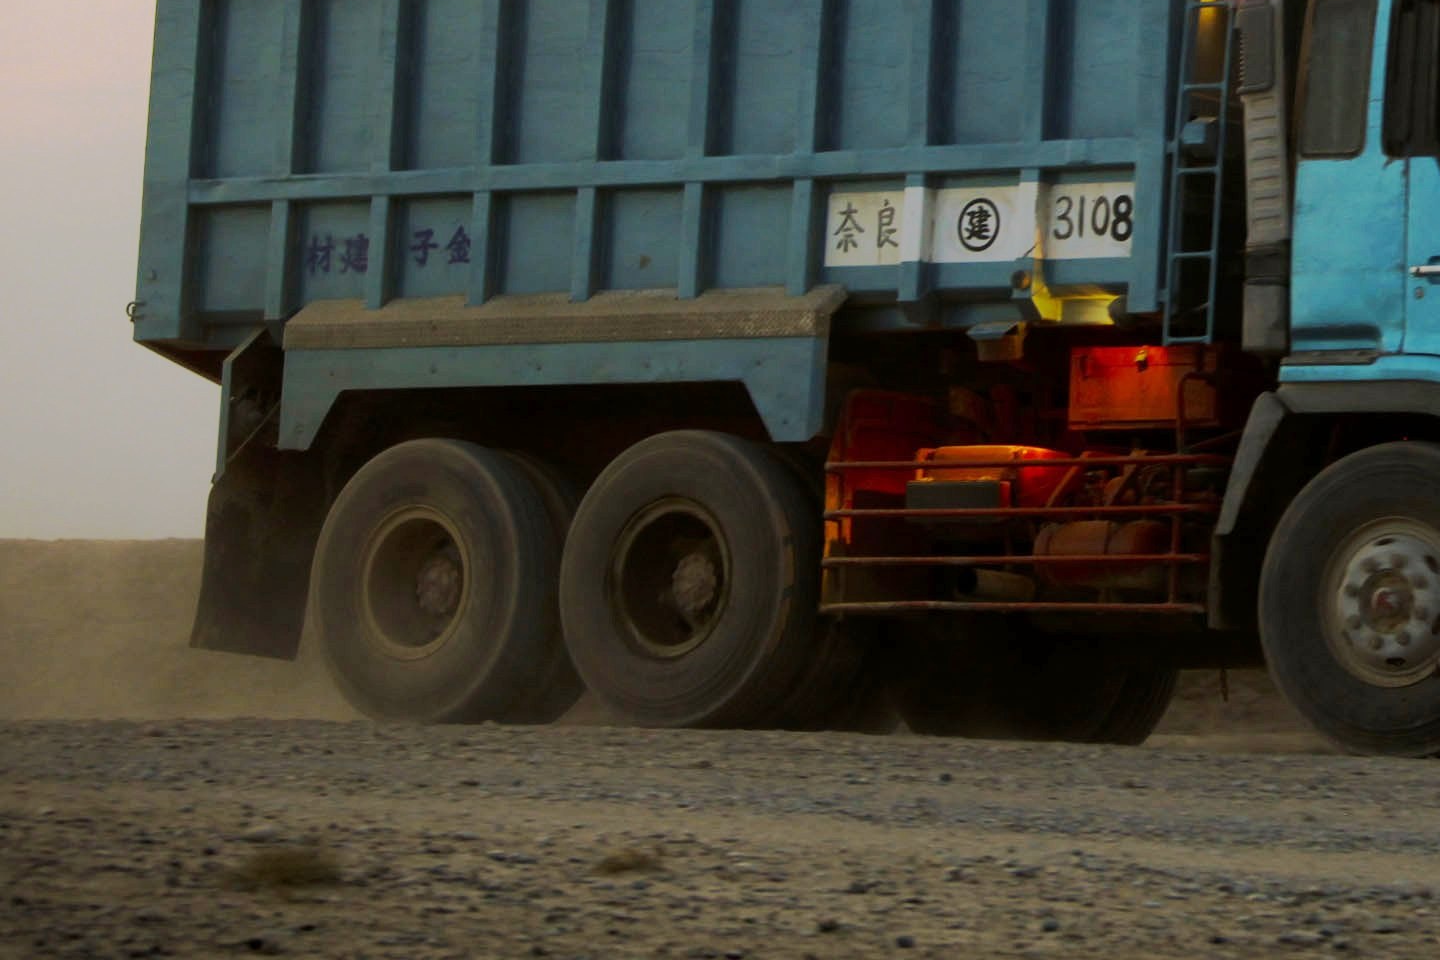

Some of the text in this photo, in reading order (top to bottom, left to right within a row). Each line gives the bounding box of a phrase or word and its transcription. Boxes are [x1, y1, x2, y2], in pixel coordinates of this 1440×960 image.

[833, 194, 1133, 253] 奈良 建 3108
